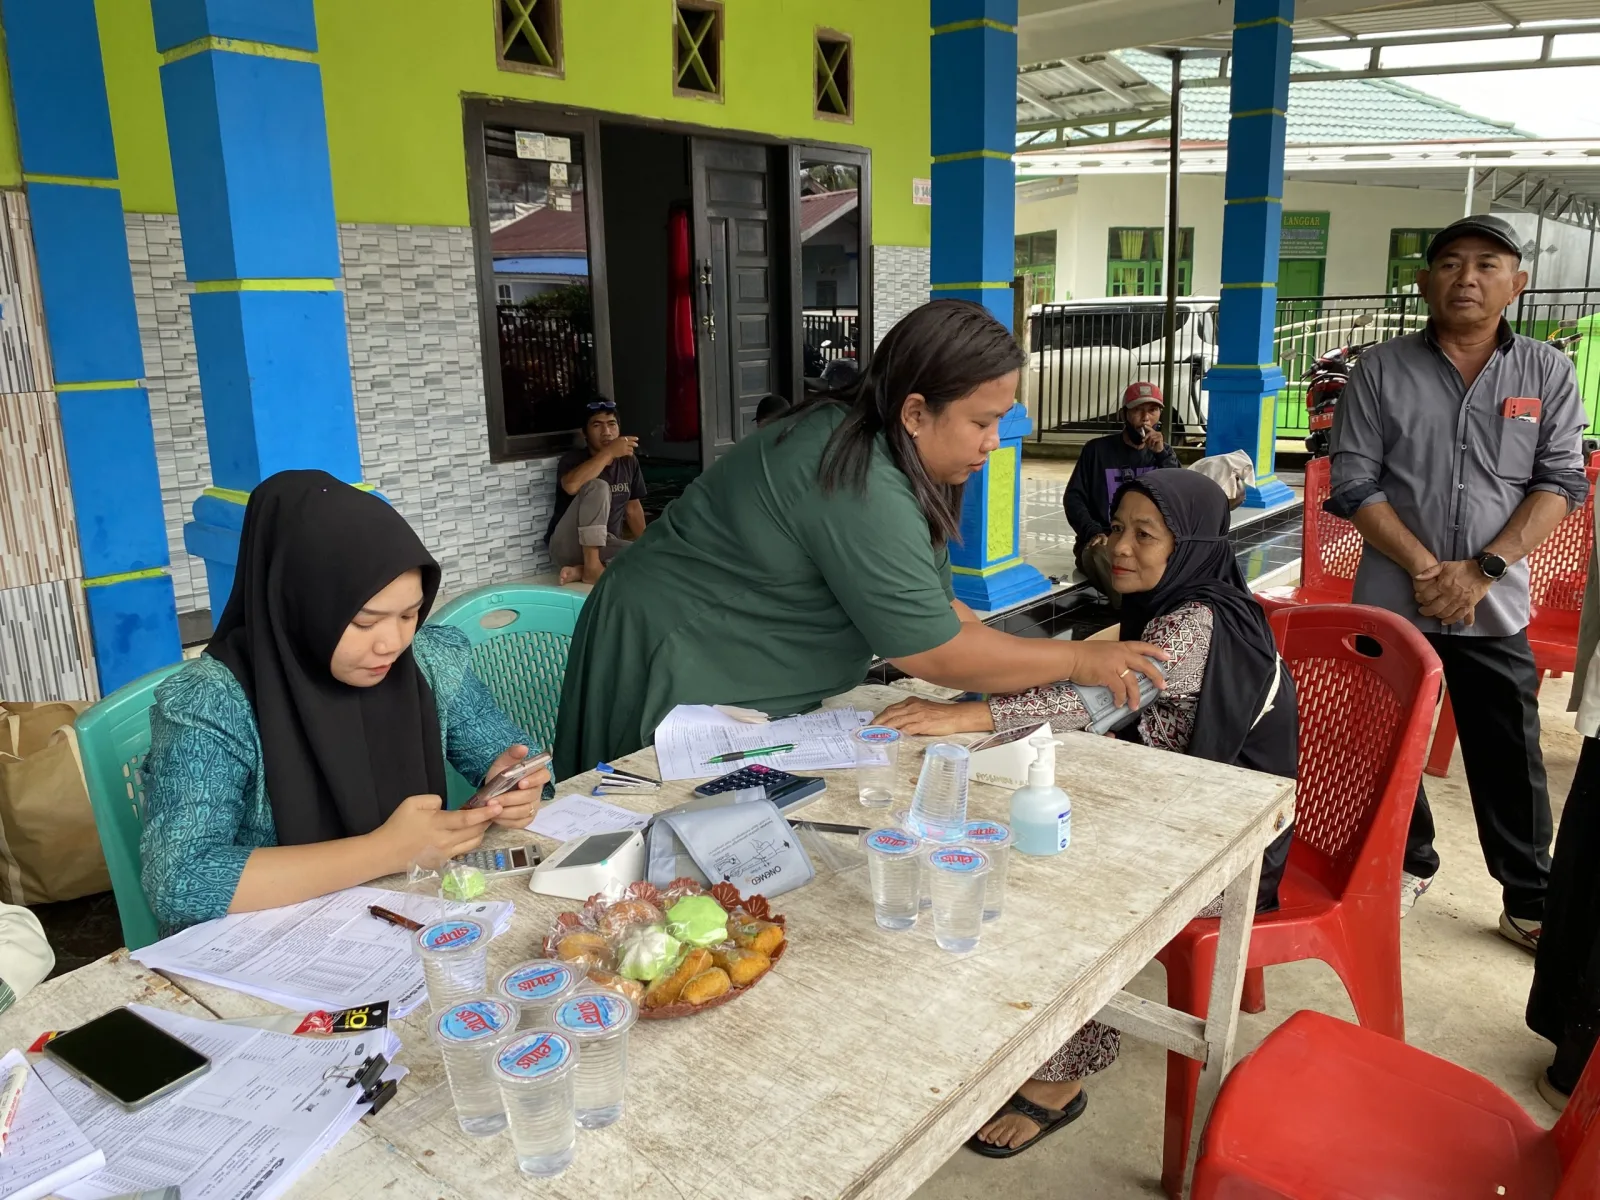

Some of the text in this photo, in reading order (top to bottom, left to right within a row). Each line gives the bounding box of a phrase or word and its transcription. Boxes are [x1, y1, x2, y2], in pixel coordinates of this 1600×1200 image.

[1283, 216, 1321, 226] LANGGAR
[940, 854, 974, 866] einis
[751, 865, 783, 886] ONEMED
[434, 925, 470, 946] einis
[517, 973, 556, 992] einis
[350, 1006, 370, 1029] 30
[455, 1010, 488, 1032] einis
[574, 1001, 601, 1025] einis
[516, 1043, 552, 1070] einis
